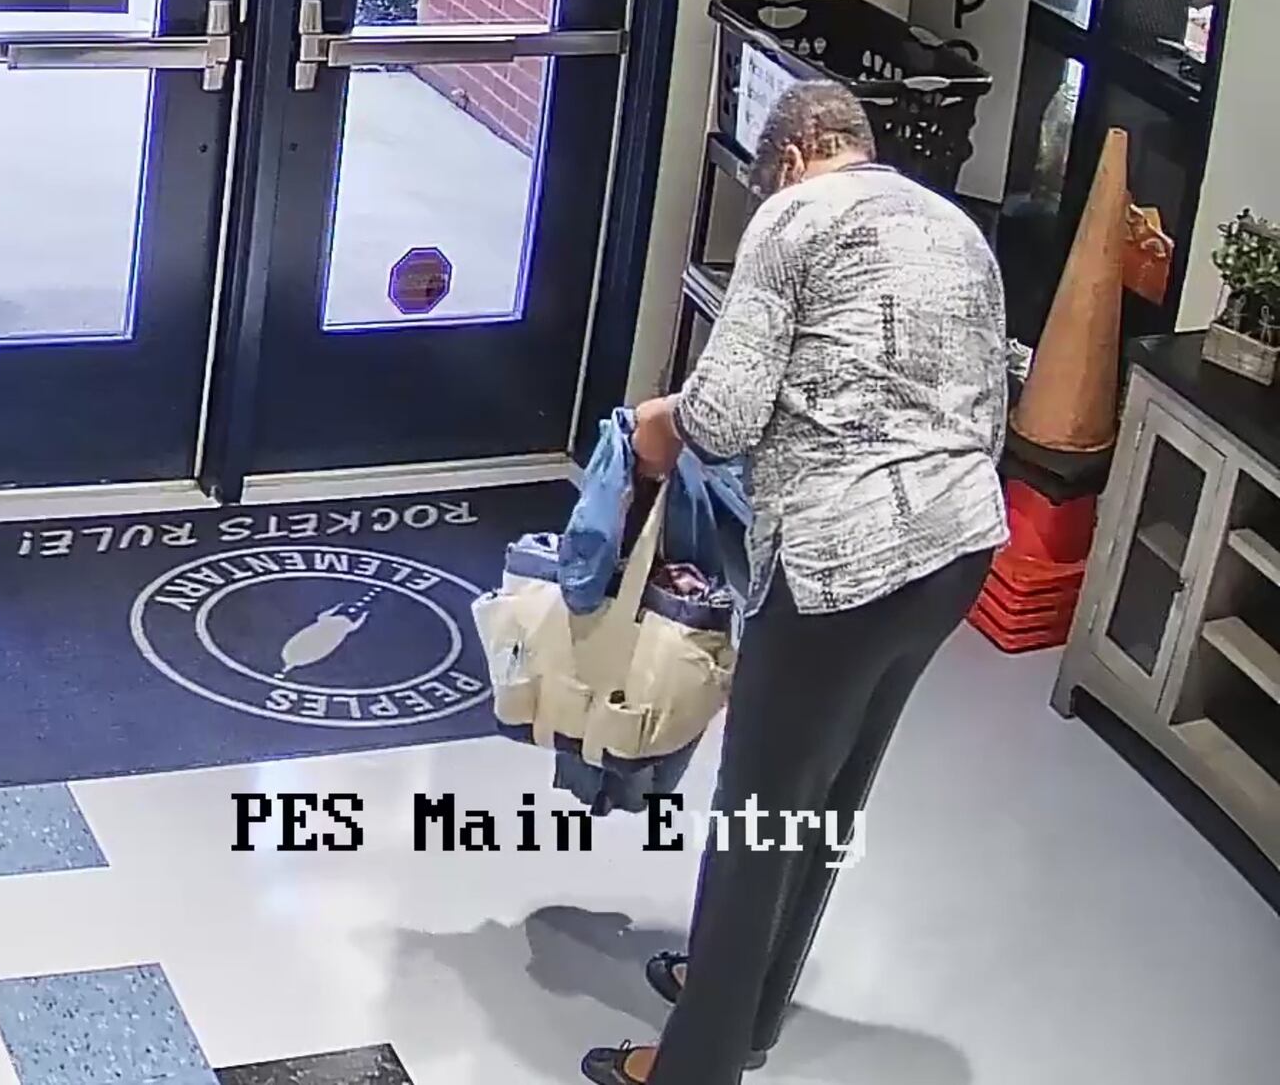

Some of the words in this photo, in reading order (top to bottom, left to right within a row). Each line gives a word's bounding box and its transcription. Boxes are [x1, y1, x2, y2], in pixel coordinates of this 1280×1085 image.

[17, 522, 198, 556] RULE!
[218, 500, 480, 542] ROCKETS
[153, 551, 441, 612] ELEMENTARY
[265, 670, 484, 719] PEEPLES
